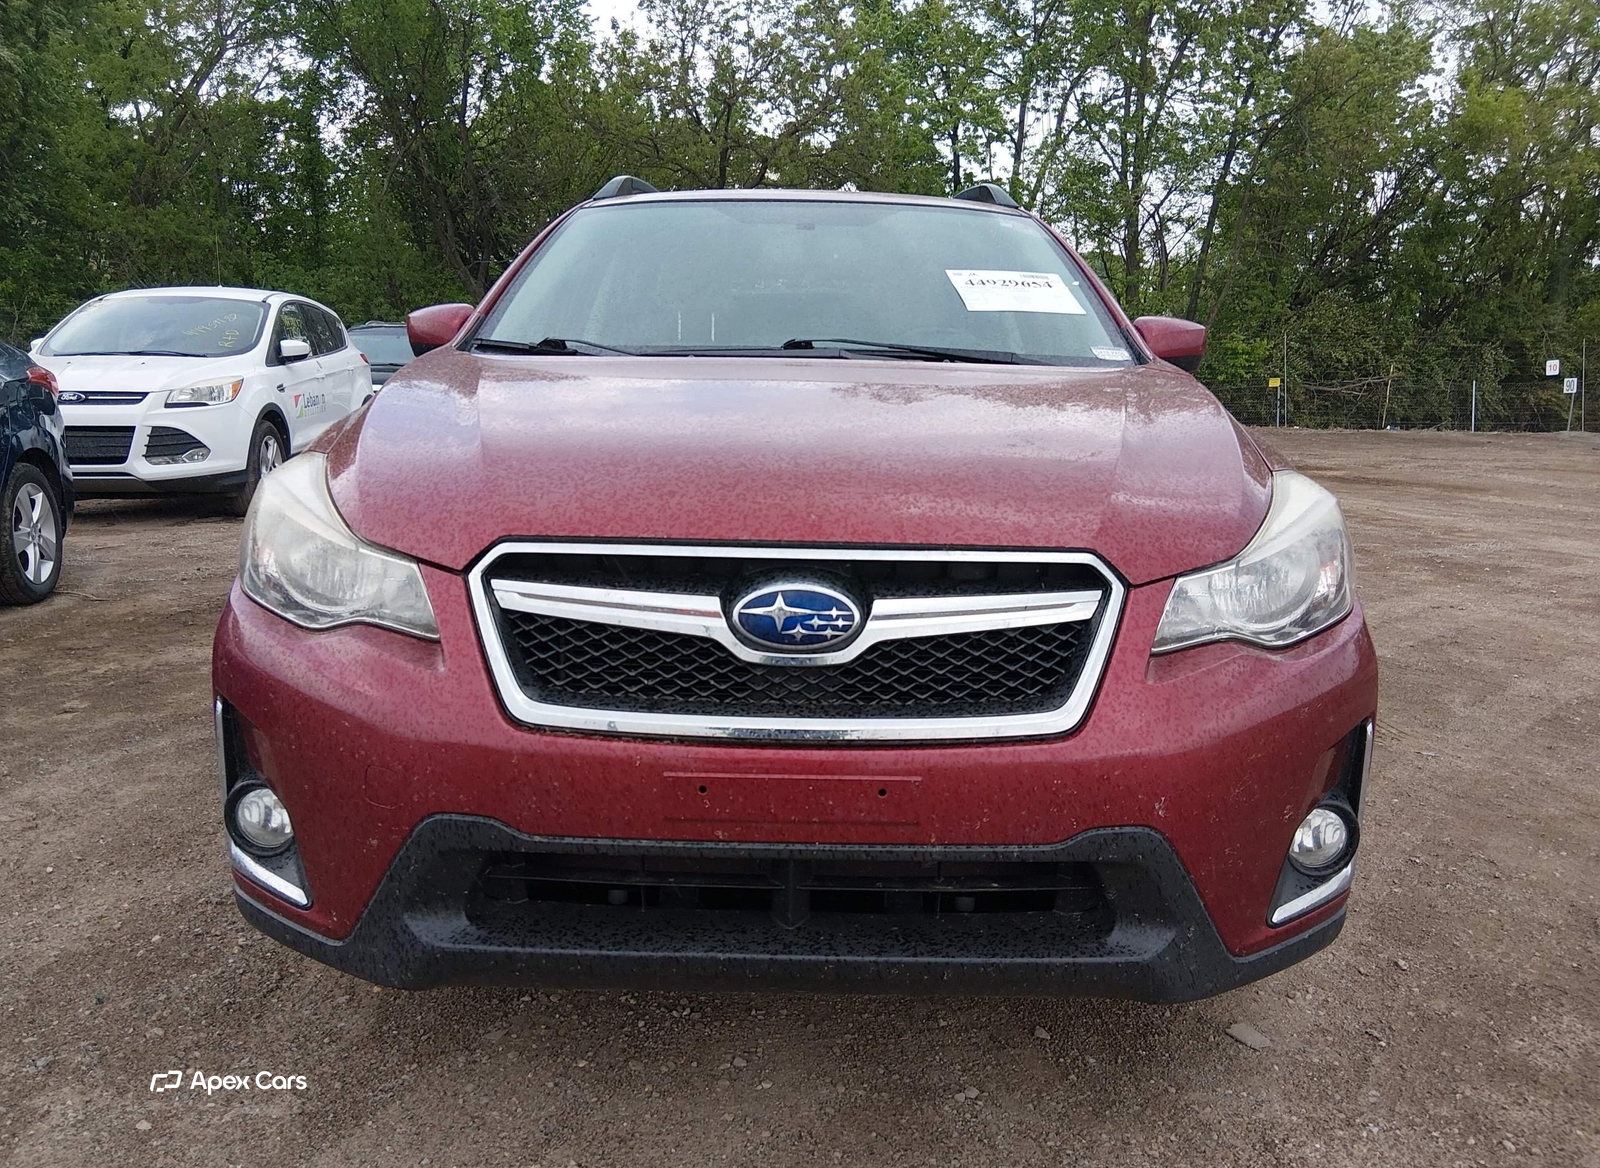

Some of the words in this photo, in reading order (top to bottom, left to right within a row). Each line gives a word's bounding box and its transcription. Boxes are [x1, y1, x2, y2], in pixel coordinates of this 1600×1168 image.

[1548, 363, 1558, 372] 10
[1565, 379, 1575, 392] 90
[60, 393, 78, 401] Ford
